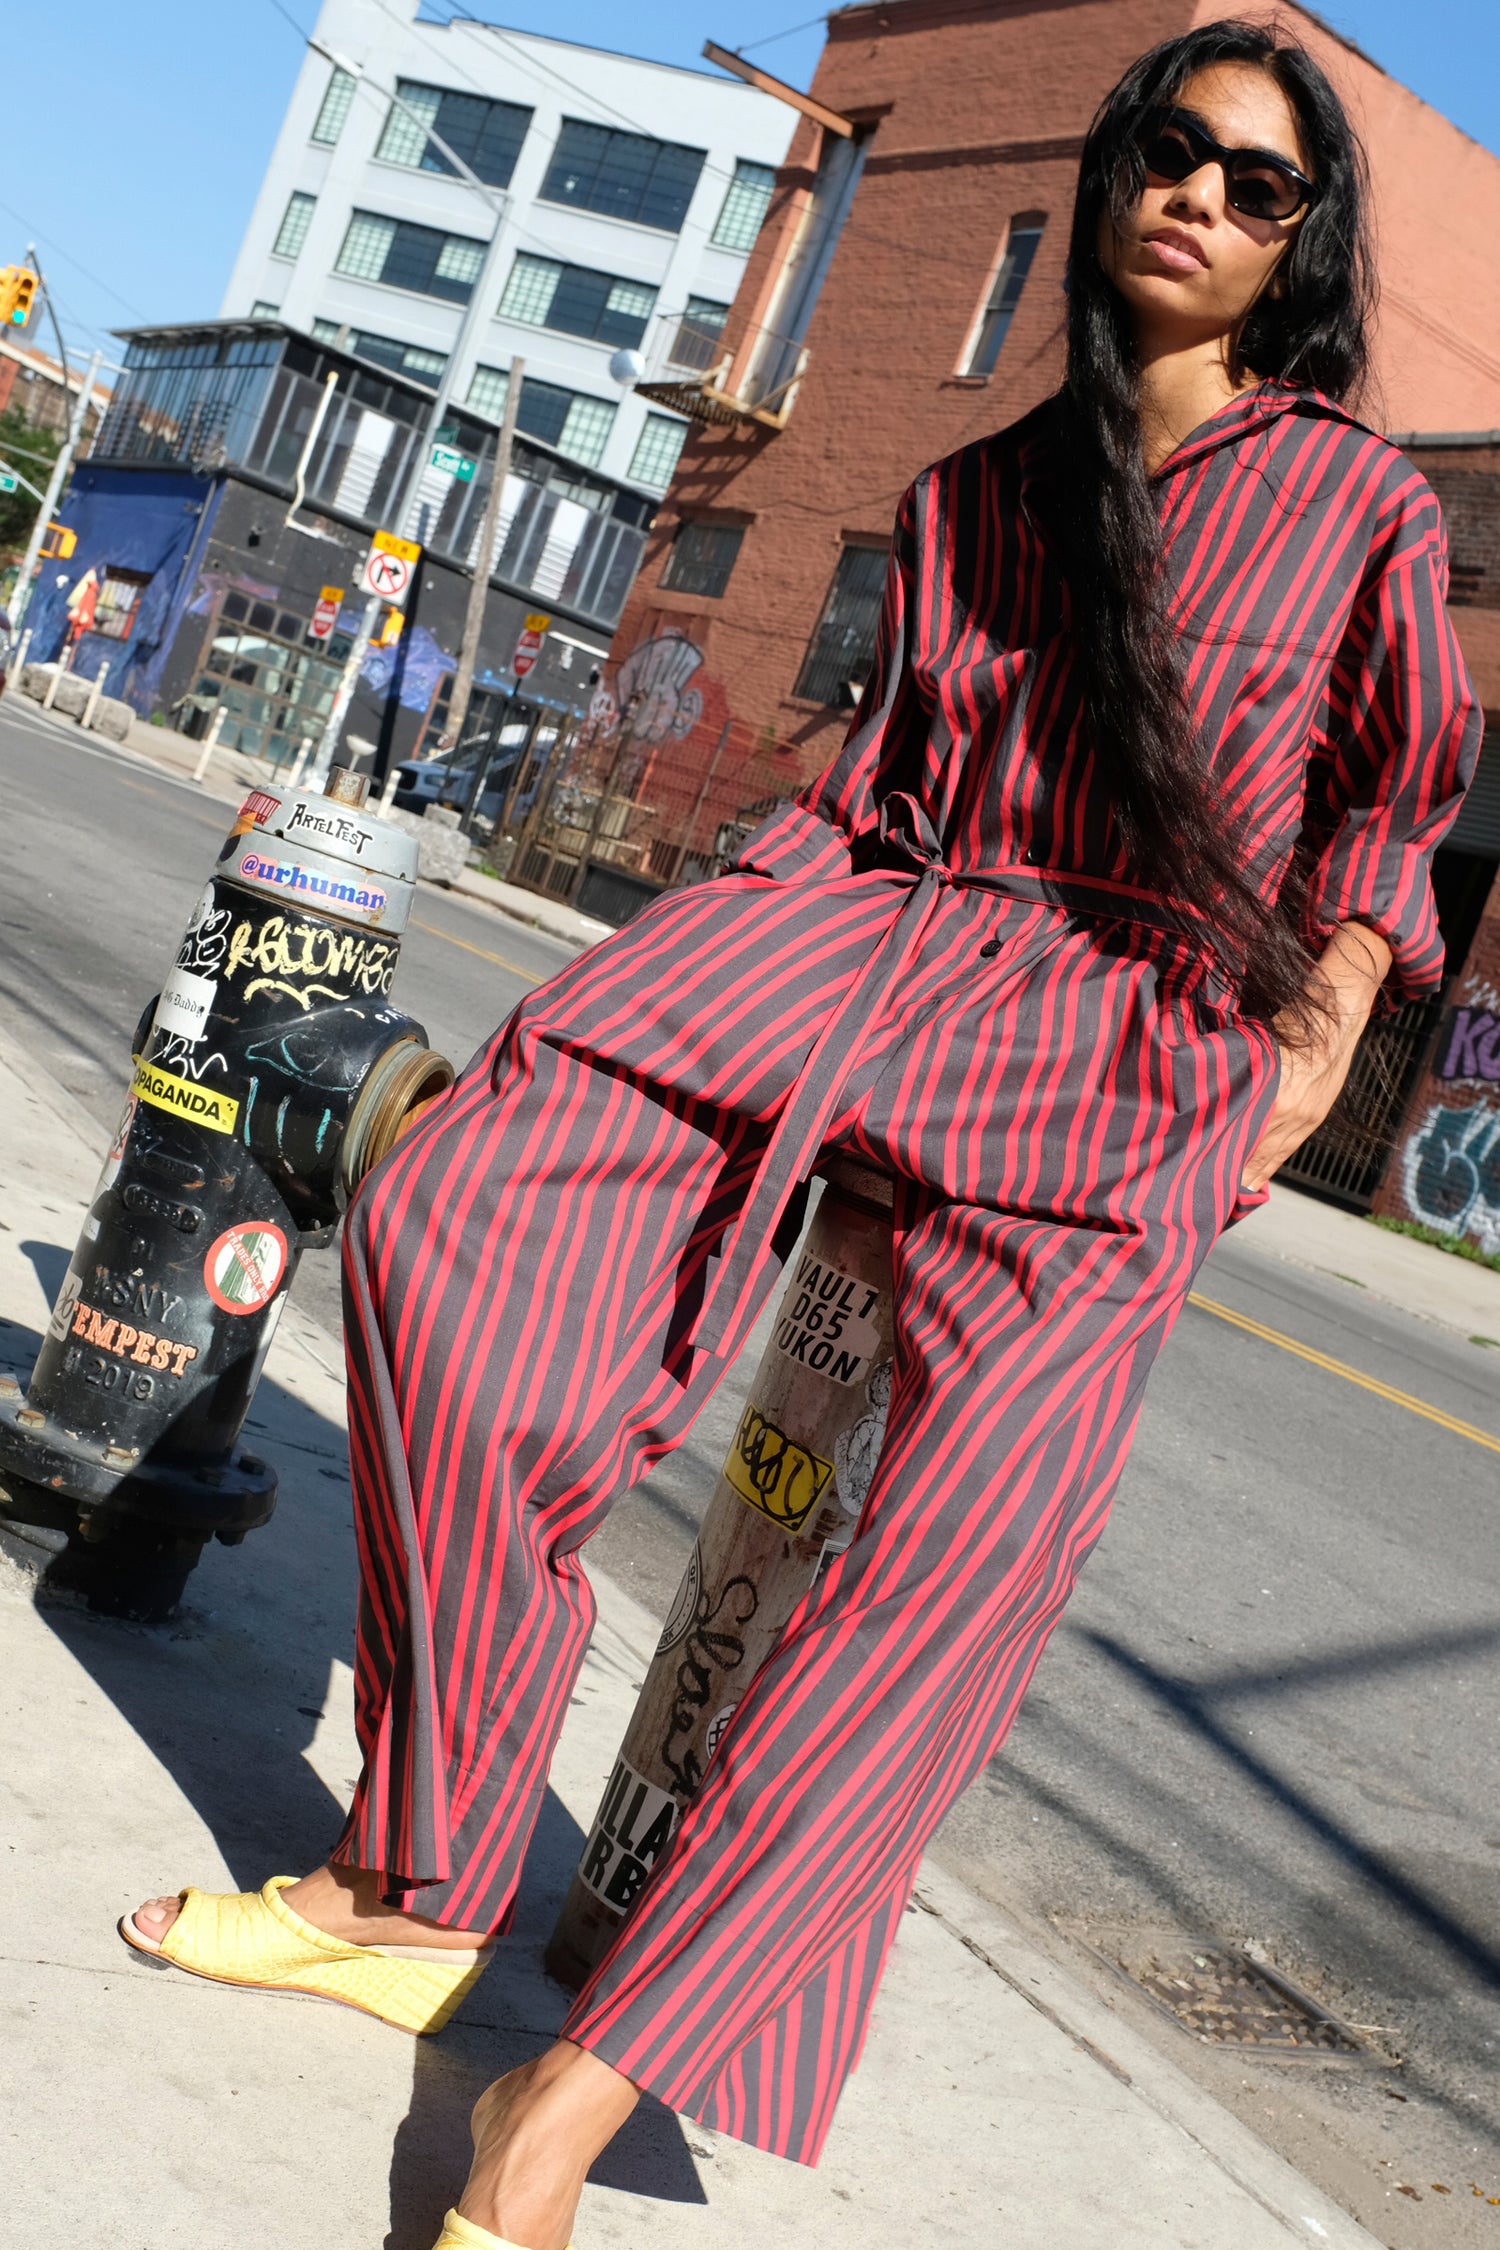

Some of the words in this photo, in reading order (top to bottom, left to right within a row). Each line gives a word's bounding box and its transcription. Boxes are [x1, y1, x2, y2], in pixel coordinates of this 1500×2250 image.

[241, 854, 385, 909] @urhuman
[227, 1231, 250, 1266] TRADES
[247, 1264, 263, 1286] ONLY
[797, 1255, 878, 1319] VAULT
[790, 1292, 849, 1340] D65
[86, 1357, 155, 1400] 2019
